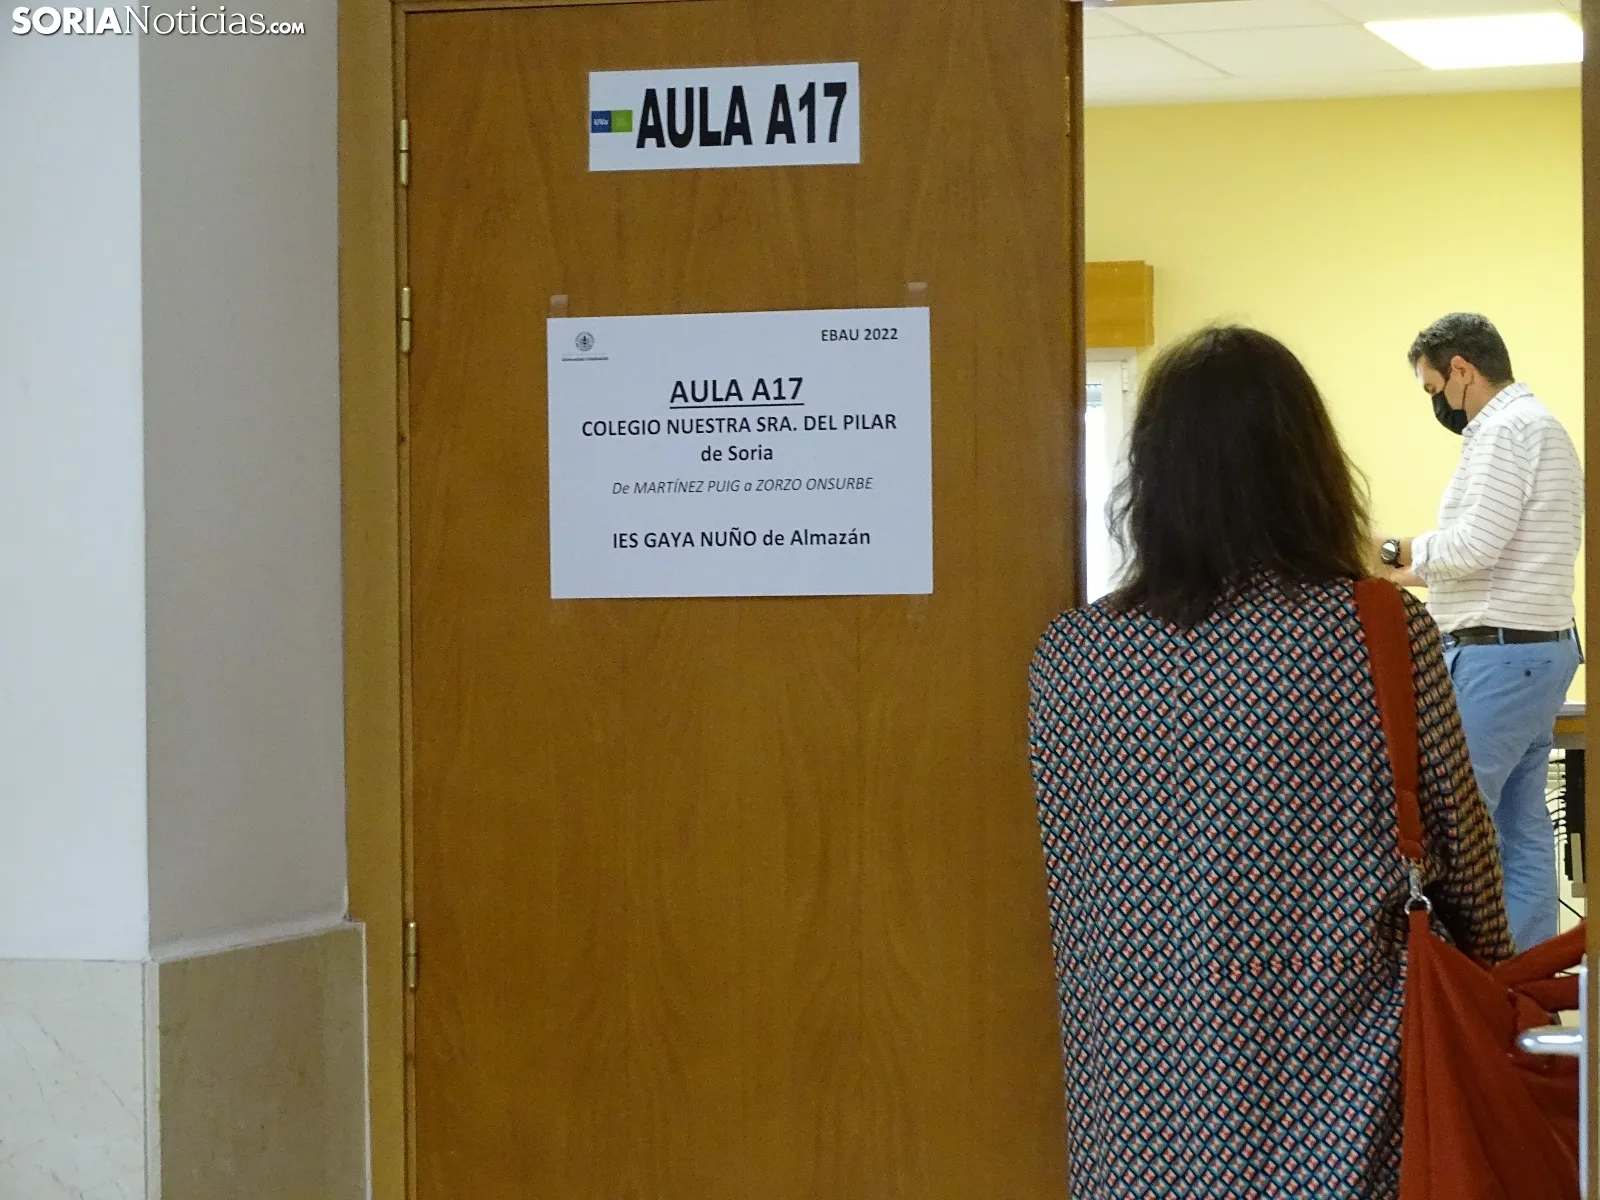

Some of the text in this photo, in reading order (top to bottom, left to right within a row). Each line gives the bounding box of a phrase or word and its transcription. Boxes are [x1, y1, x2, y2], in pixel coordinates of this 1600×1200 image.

[636, 81, 847, 149] AULA A17
[820, 328, 898, 342] EBAU 2022
[669, 377, 804, 404] AULA A17
[582, 414, 897, 436] COLEGIO NUESTRA SRA. DEL PILAR
[701, 444, 774, 462] de Soria
[612, 477, 874, 495] De MARTÍNEZ PUIG a ZORZO ONSURBE
[612, 527, 871, 549] IES GAYA NUÑO de Almazán
